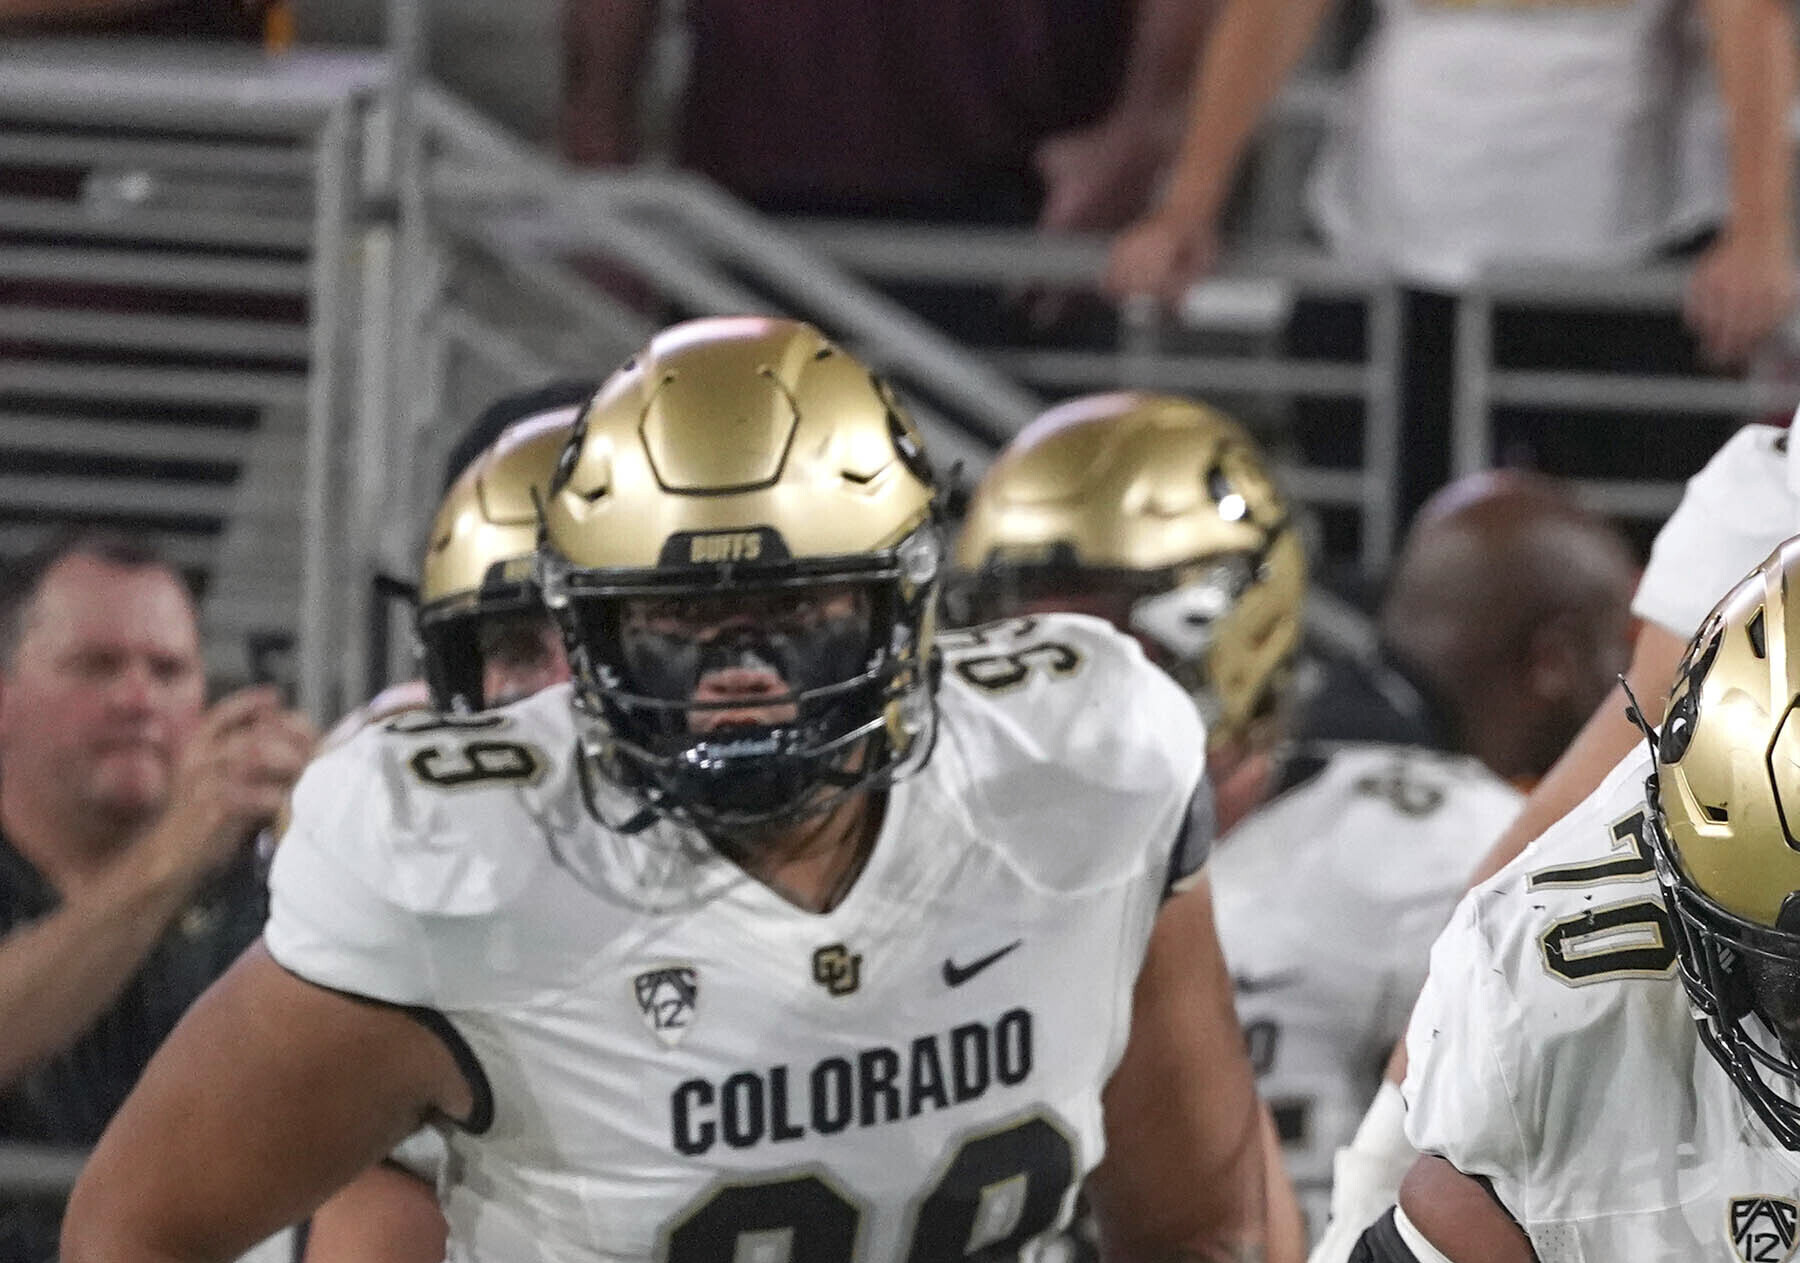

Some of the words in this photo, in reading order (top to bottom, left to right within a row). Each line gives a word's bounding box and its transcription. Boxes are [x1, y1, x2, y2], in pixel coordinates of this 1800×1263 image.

[384, 714, 541, 788] 9
[1526, 802, 1682, 988] 70
[812, 943, 863, 997] CU
[654, 1000, 687, 1030] 12
[670, 1007, 1034, 1157] COLORADO
[1730, 1198, 1798, 1251] PAC
[1744, 1232, 1782, 1263] 12
